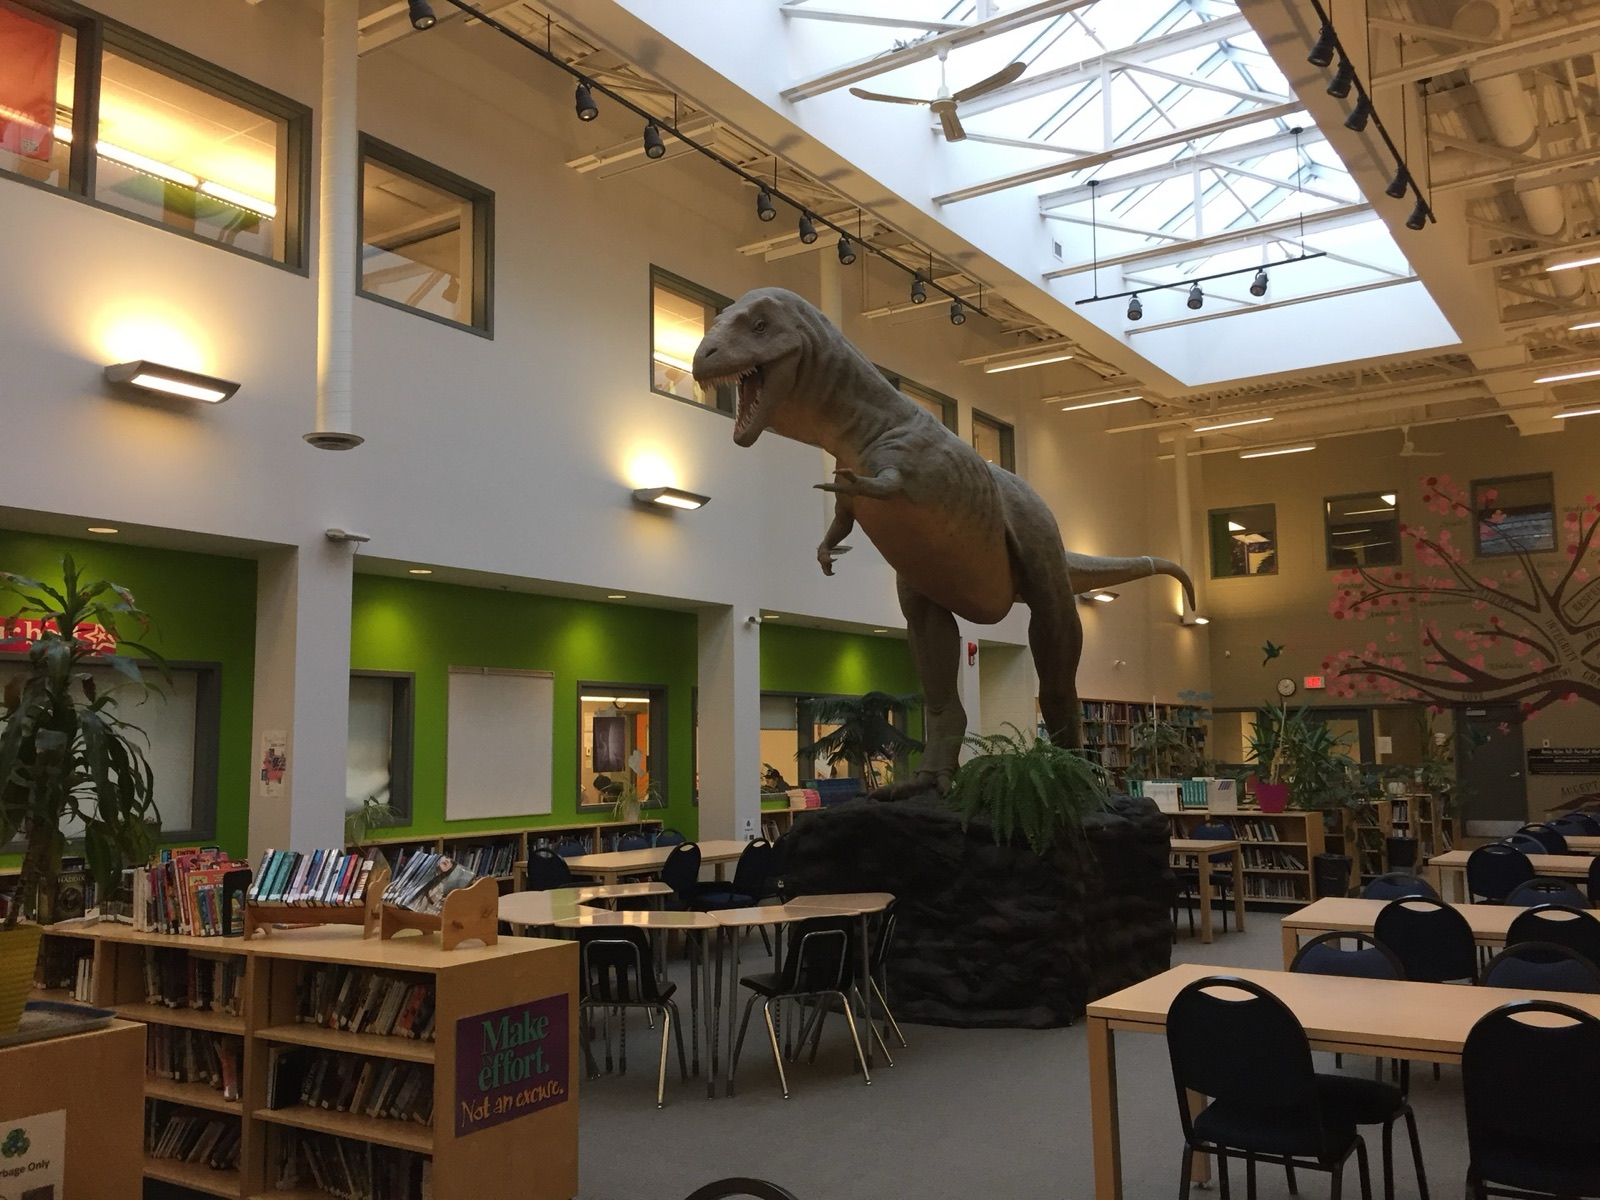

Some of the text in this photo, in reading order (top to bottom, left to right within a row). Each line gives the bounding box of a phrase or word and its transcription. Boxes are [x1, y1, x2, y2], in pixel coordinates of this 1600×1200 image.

[1545, 619, 1579, 662] INTEGRITY
[480, 1010, 549, 1056] Make
[478, 1044, 550, 1091] effort.
[462, 1081, 564, 1127] Not an excuse.
[28, 1160, 50, 1171] Only
